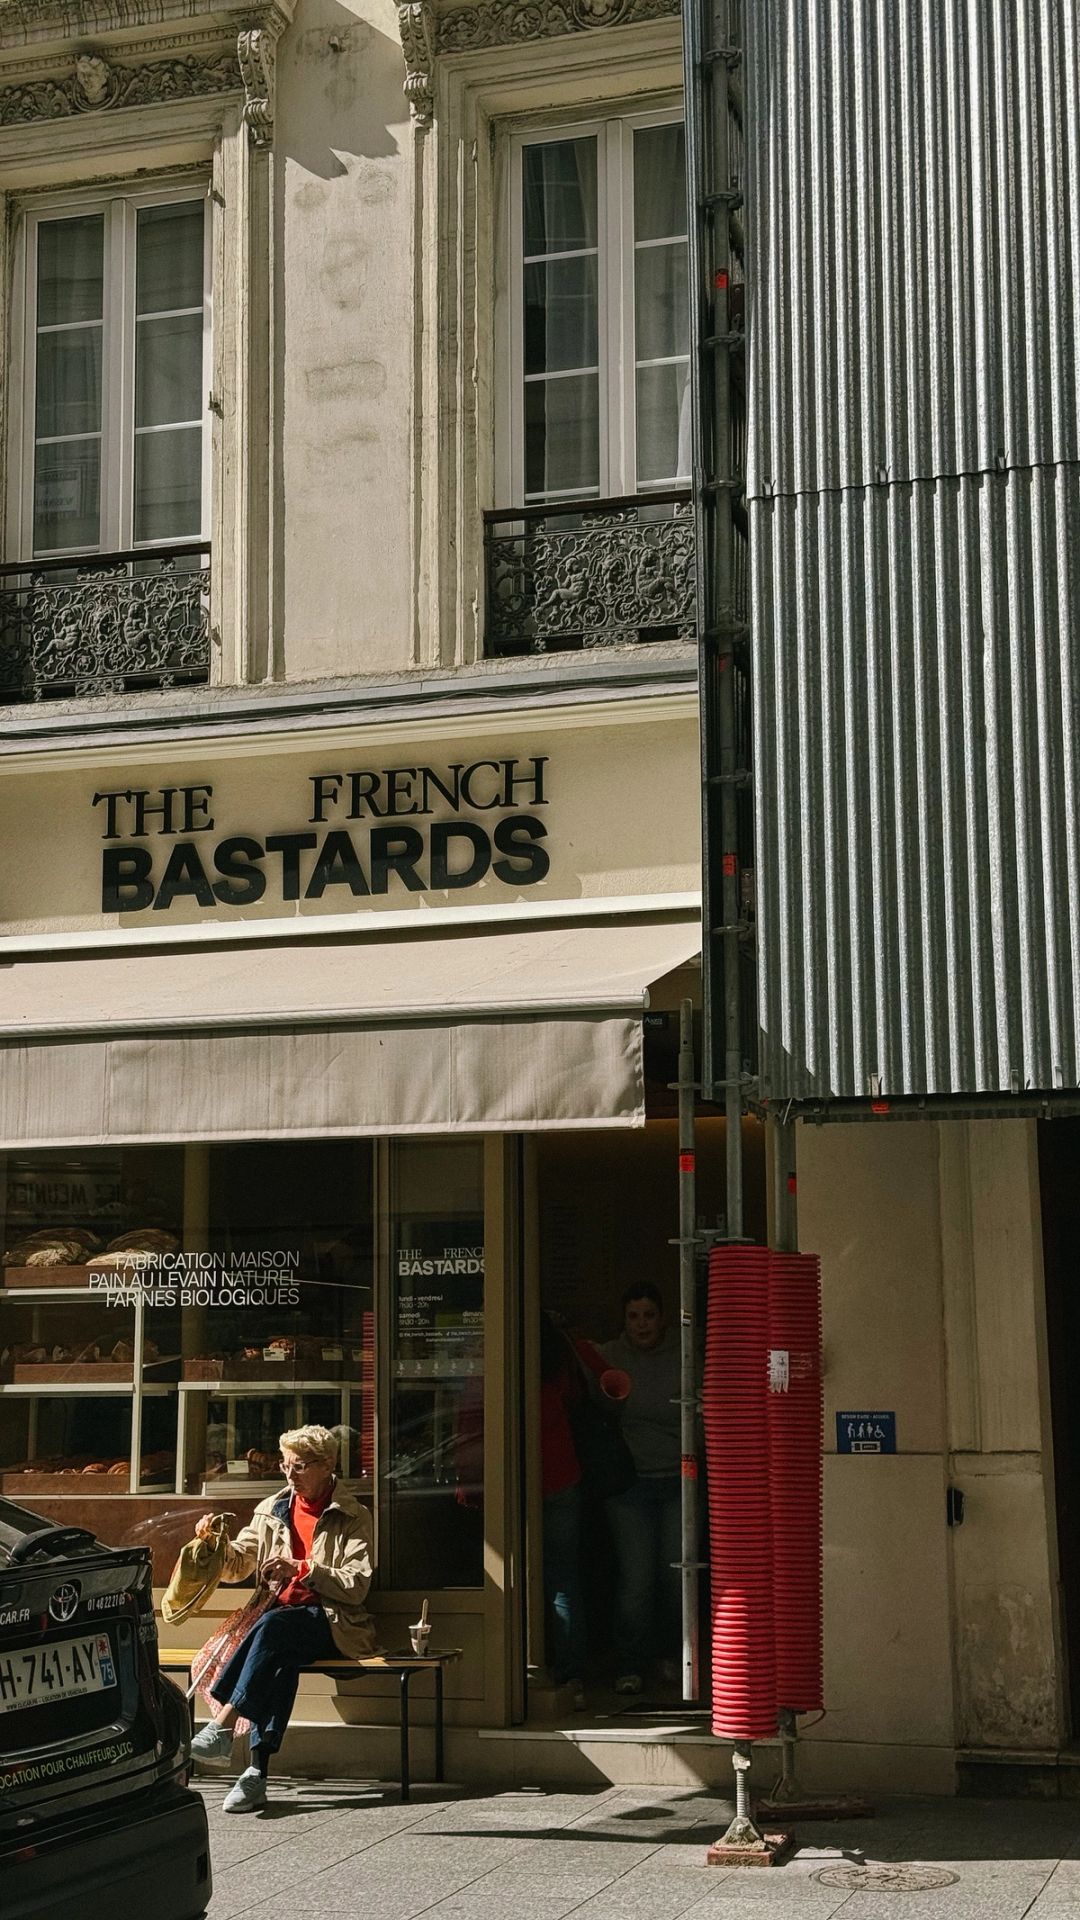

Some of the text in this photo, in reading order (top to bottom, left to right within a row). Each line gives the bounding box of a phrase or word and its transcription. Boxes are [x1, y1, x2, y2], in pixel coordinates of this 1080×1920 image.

[91, 757, 550, 840] THE FRENCH
[102, 815, 550, 914] BASTARDS
[116, 1250, 300, 1271] FABRICATION MAISON
[397, 1249, 422, 1260] THE
[89, 1270, 300, 1289] PAIN AU LEVAIN NATUREL
[106, 1288, 300, 1308] FARINES BIOLOGIQUES
[104, 1596, 111, 1608] 22
[0, 1608, 30, 1625] CAR.FR
[101, 1662, 114, 1681] 75
[0, 1741, 134, 1788] OCATION POUR CHAUFFEURS VTC
